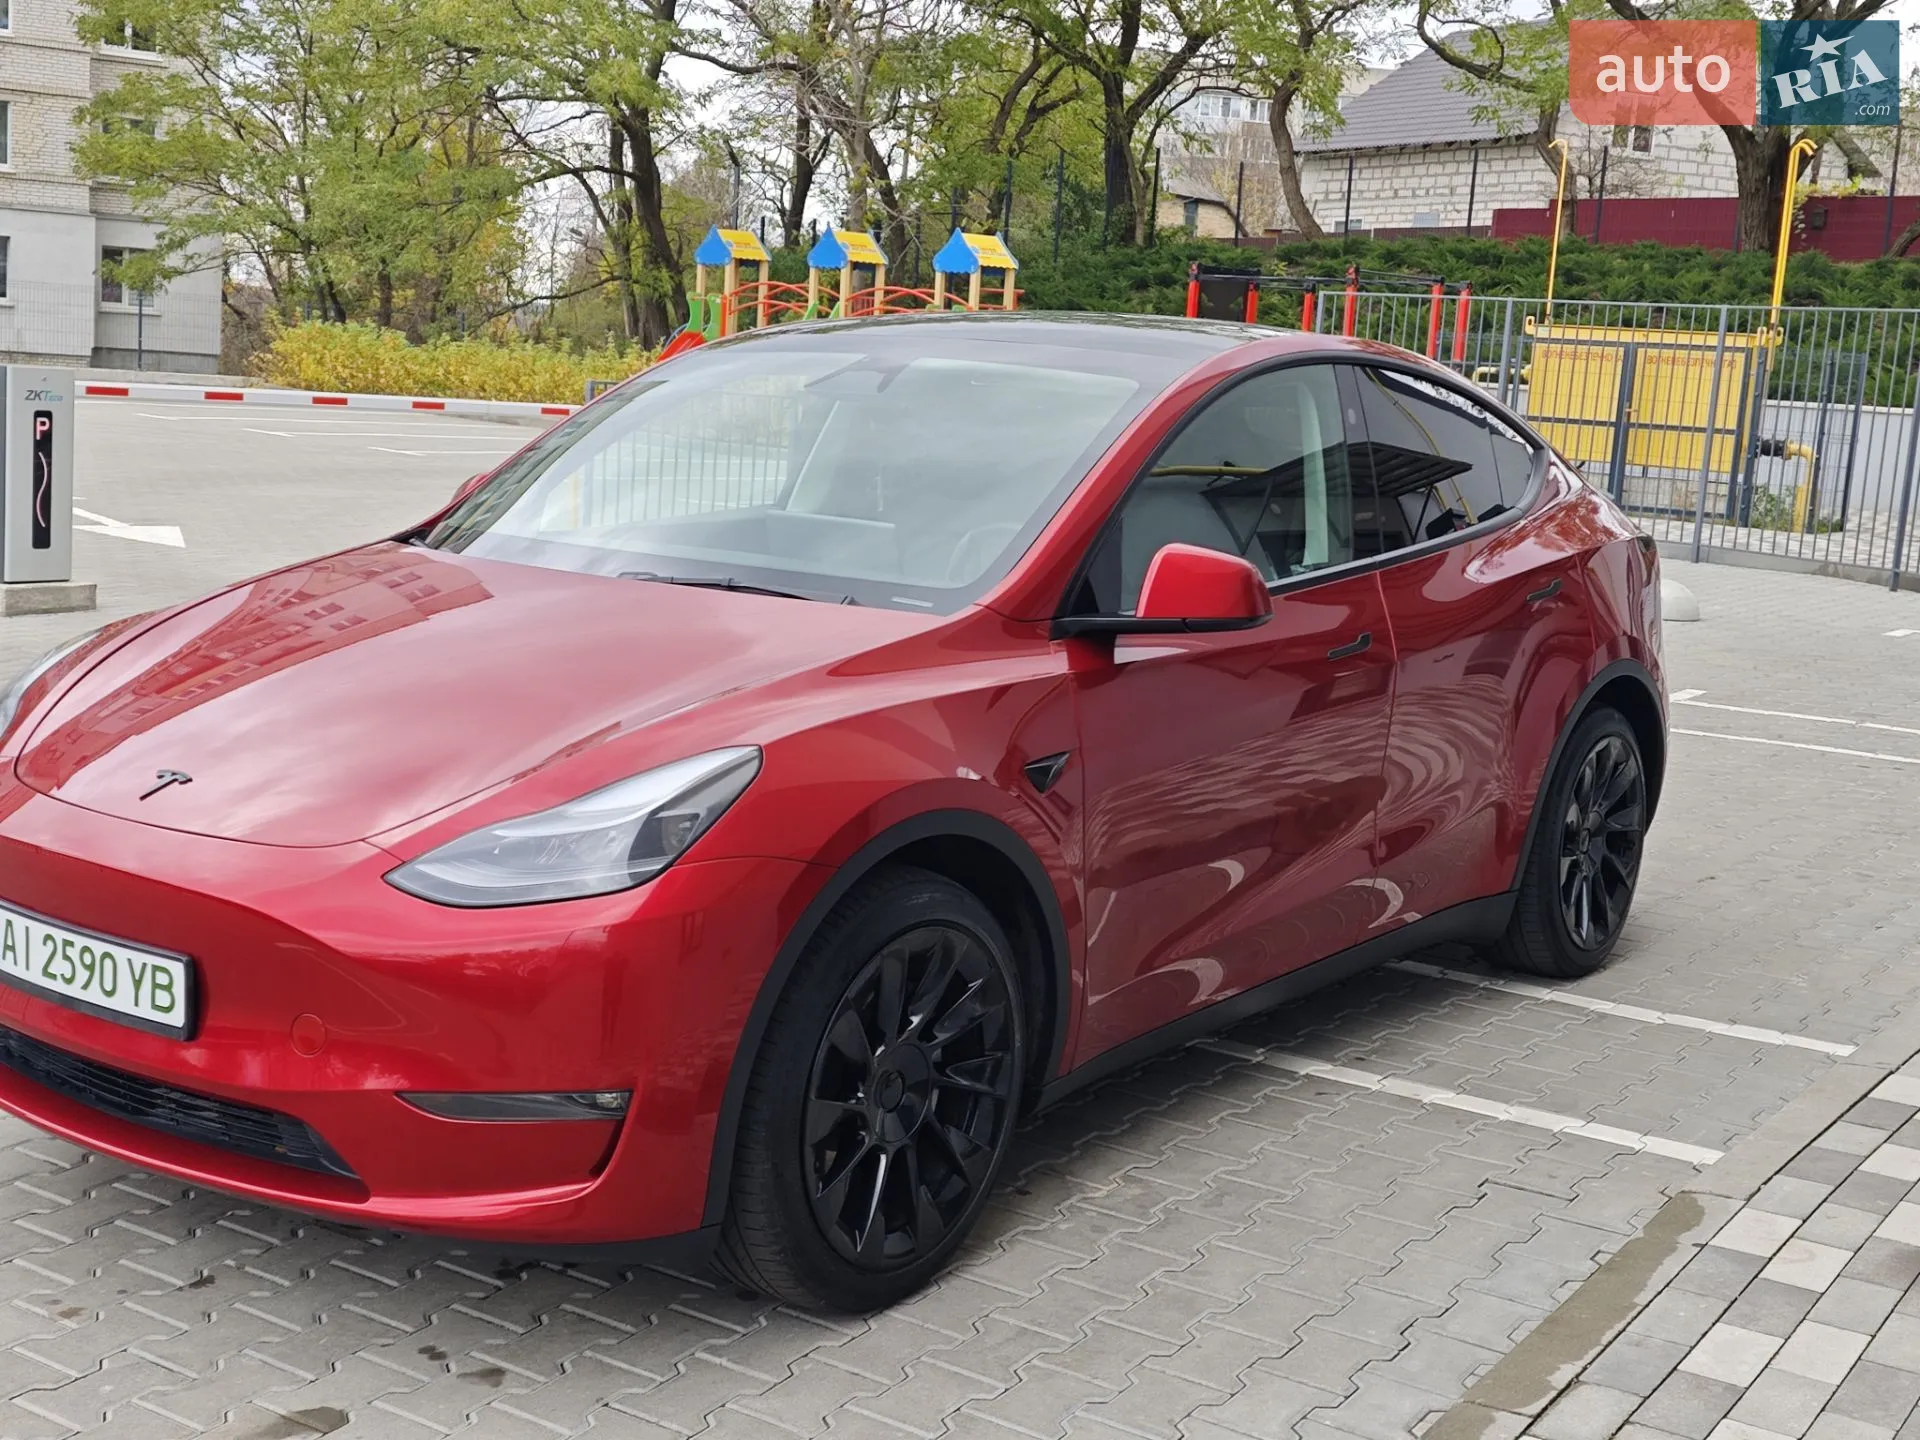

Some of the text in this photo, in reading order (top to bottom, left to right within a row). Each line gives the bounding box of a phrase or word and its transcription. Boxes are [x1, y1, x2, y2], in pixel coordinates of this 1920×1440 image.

[36, 417, 50, 440] P
[2, 918, 176, 1014] AI 2590 YB
